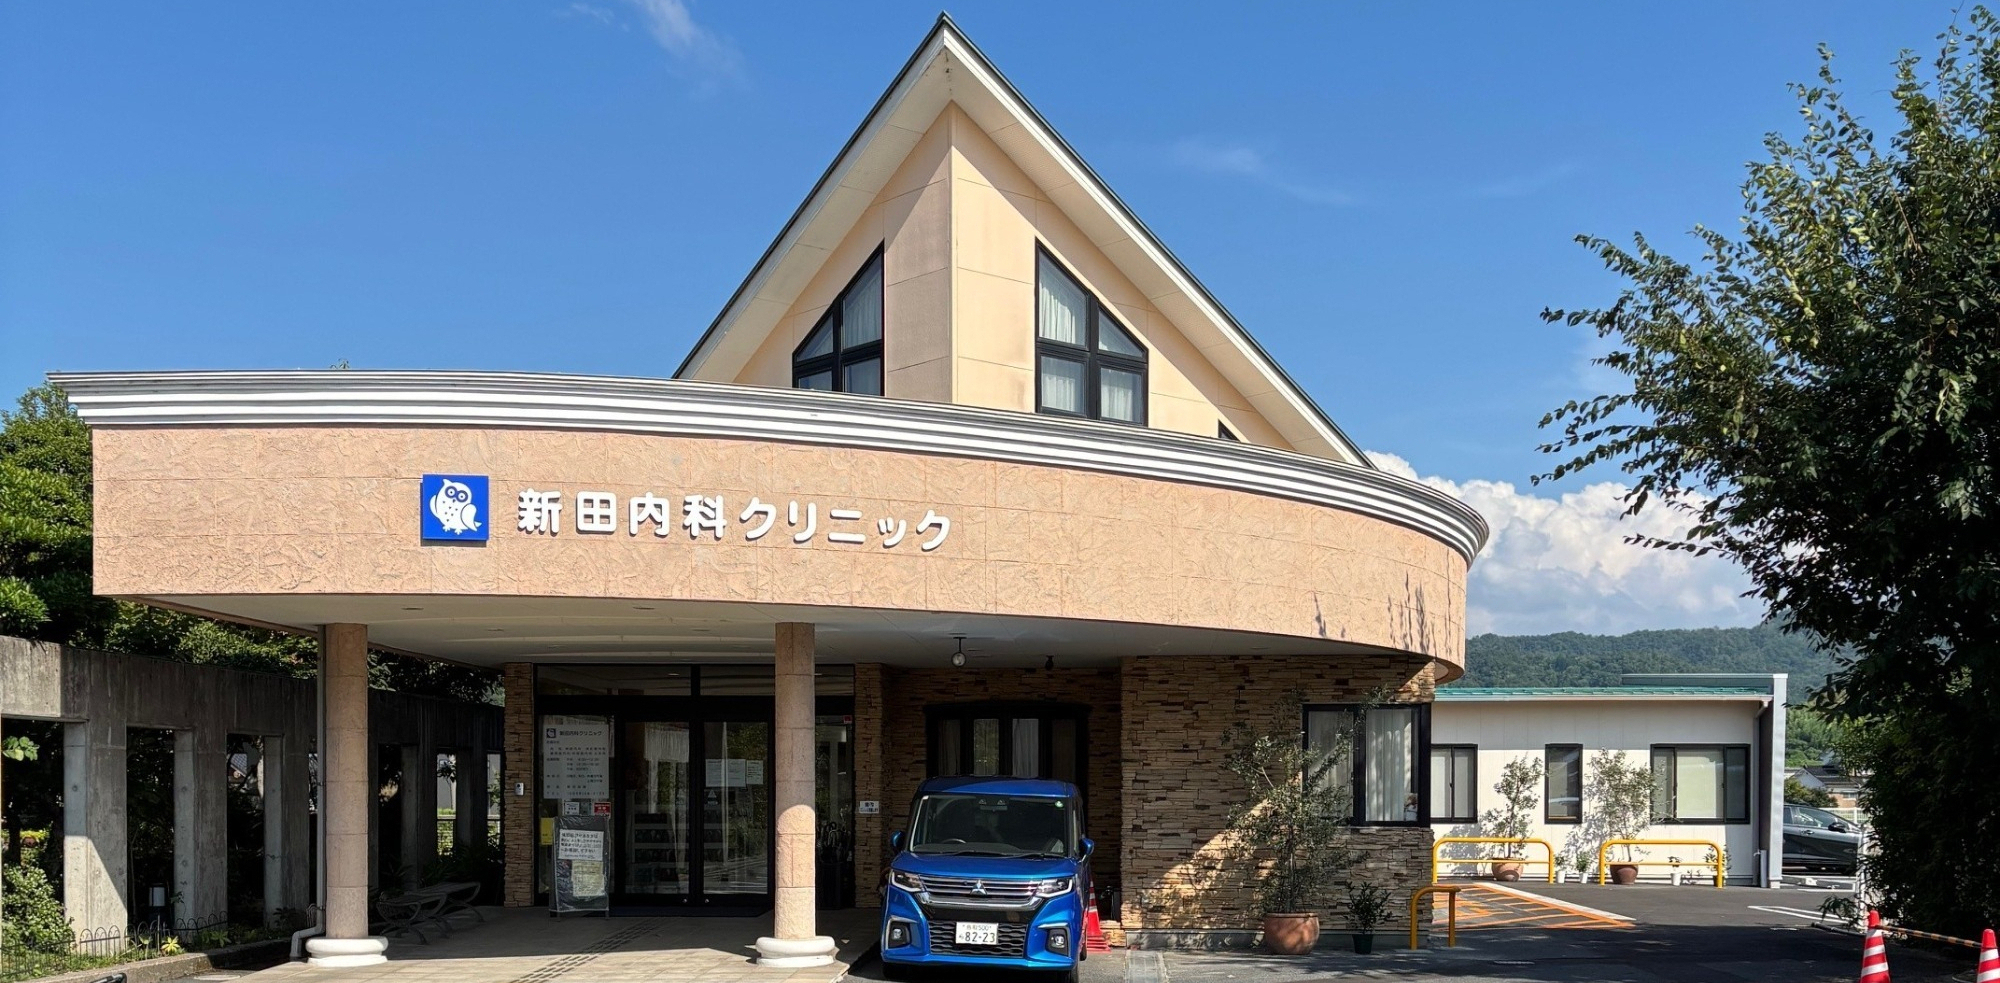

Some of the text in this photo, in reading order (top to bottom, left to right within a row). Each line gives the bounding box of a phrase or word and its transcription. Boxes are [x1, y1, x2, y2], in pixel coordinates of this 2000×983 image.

[518, 488, 952, 552] 新田内科クリニック
[965, 931, 995, 943] 82-23
